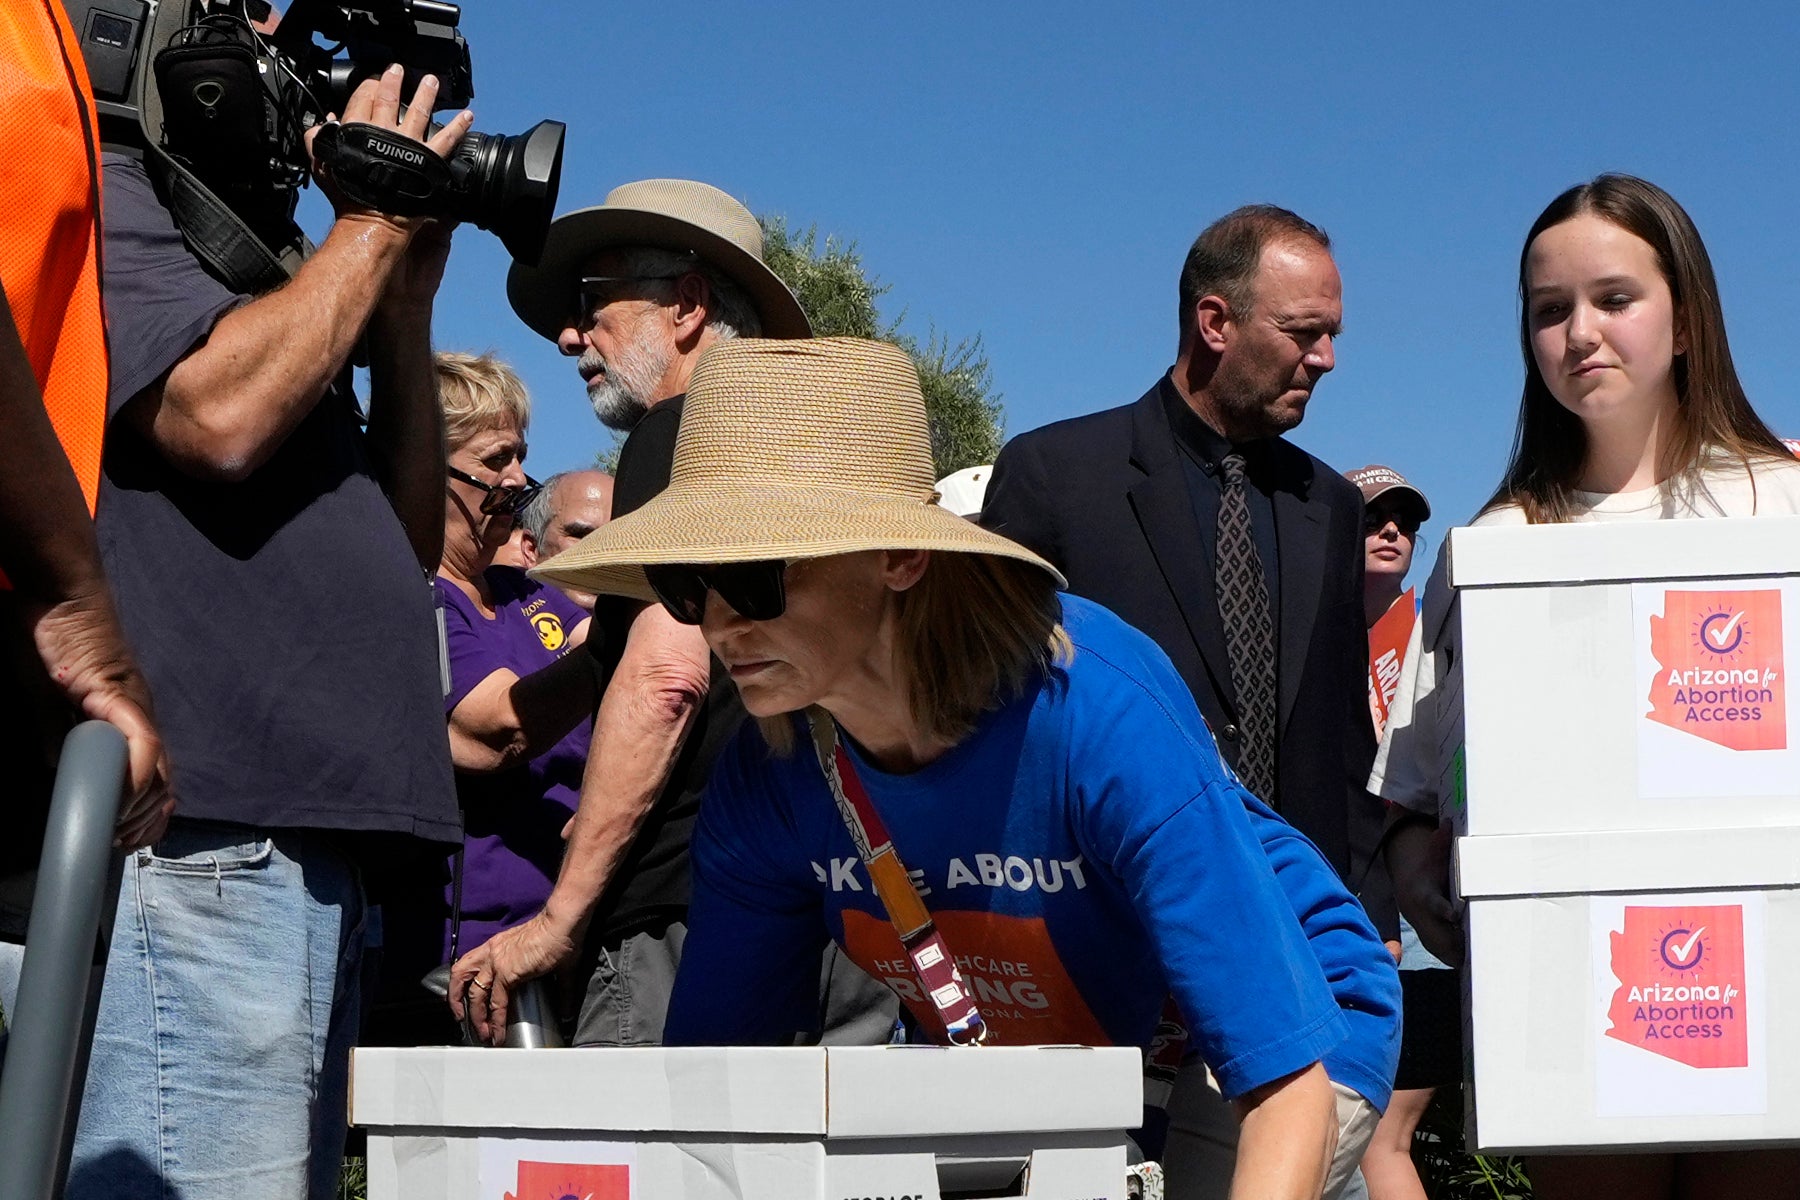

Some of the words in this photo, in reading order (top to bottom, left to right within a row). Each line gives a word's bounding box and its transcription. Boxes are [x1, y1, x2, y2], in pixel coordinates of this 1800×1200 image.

[367, 138, 424, 166] FUJINON
[1667, 667, 1759, 686] Arizona
[1762, 667, 1778, 688] for
[1674, 685, 1773, 705] Abortion
[1685, 706, 1762, 722] Access
[946, 853, 1088, 893] ABOUT
[1627, 983, 1720, 1003] Arizona
[1723, 983, 1739, 1005] for
[1633, 1002, 1733, 1021] Abortion
[1645, 1023, 1722, 1039] Access
